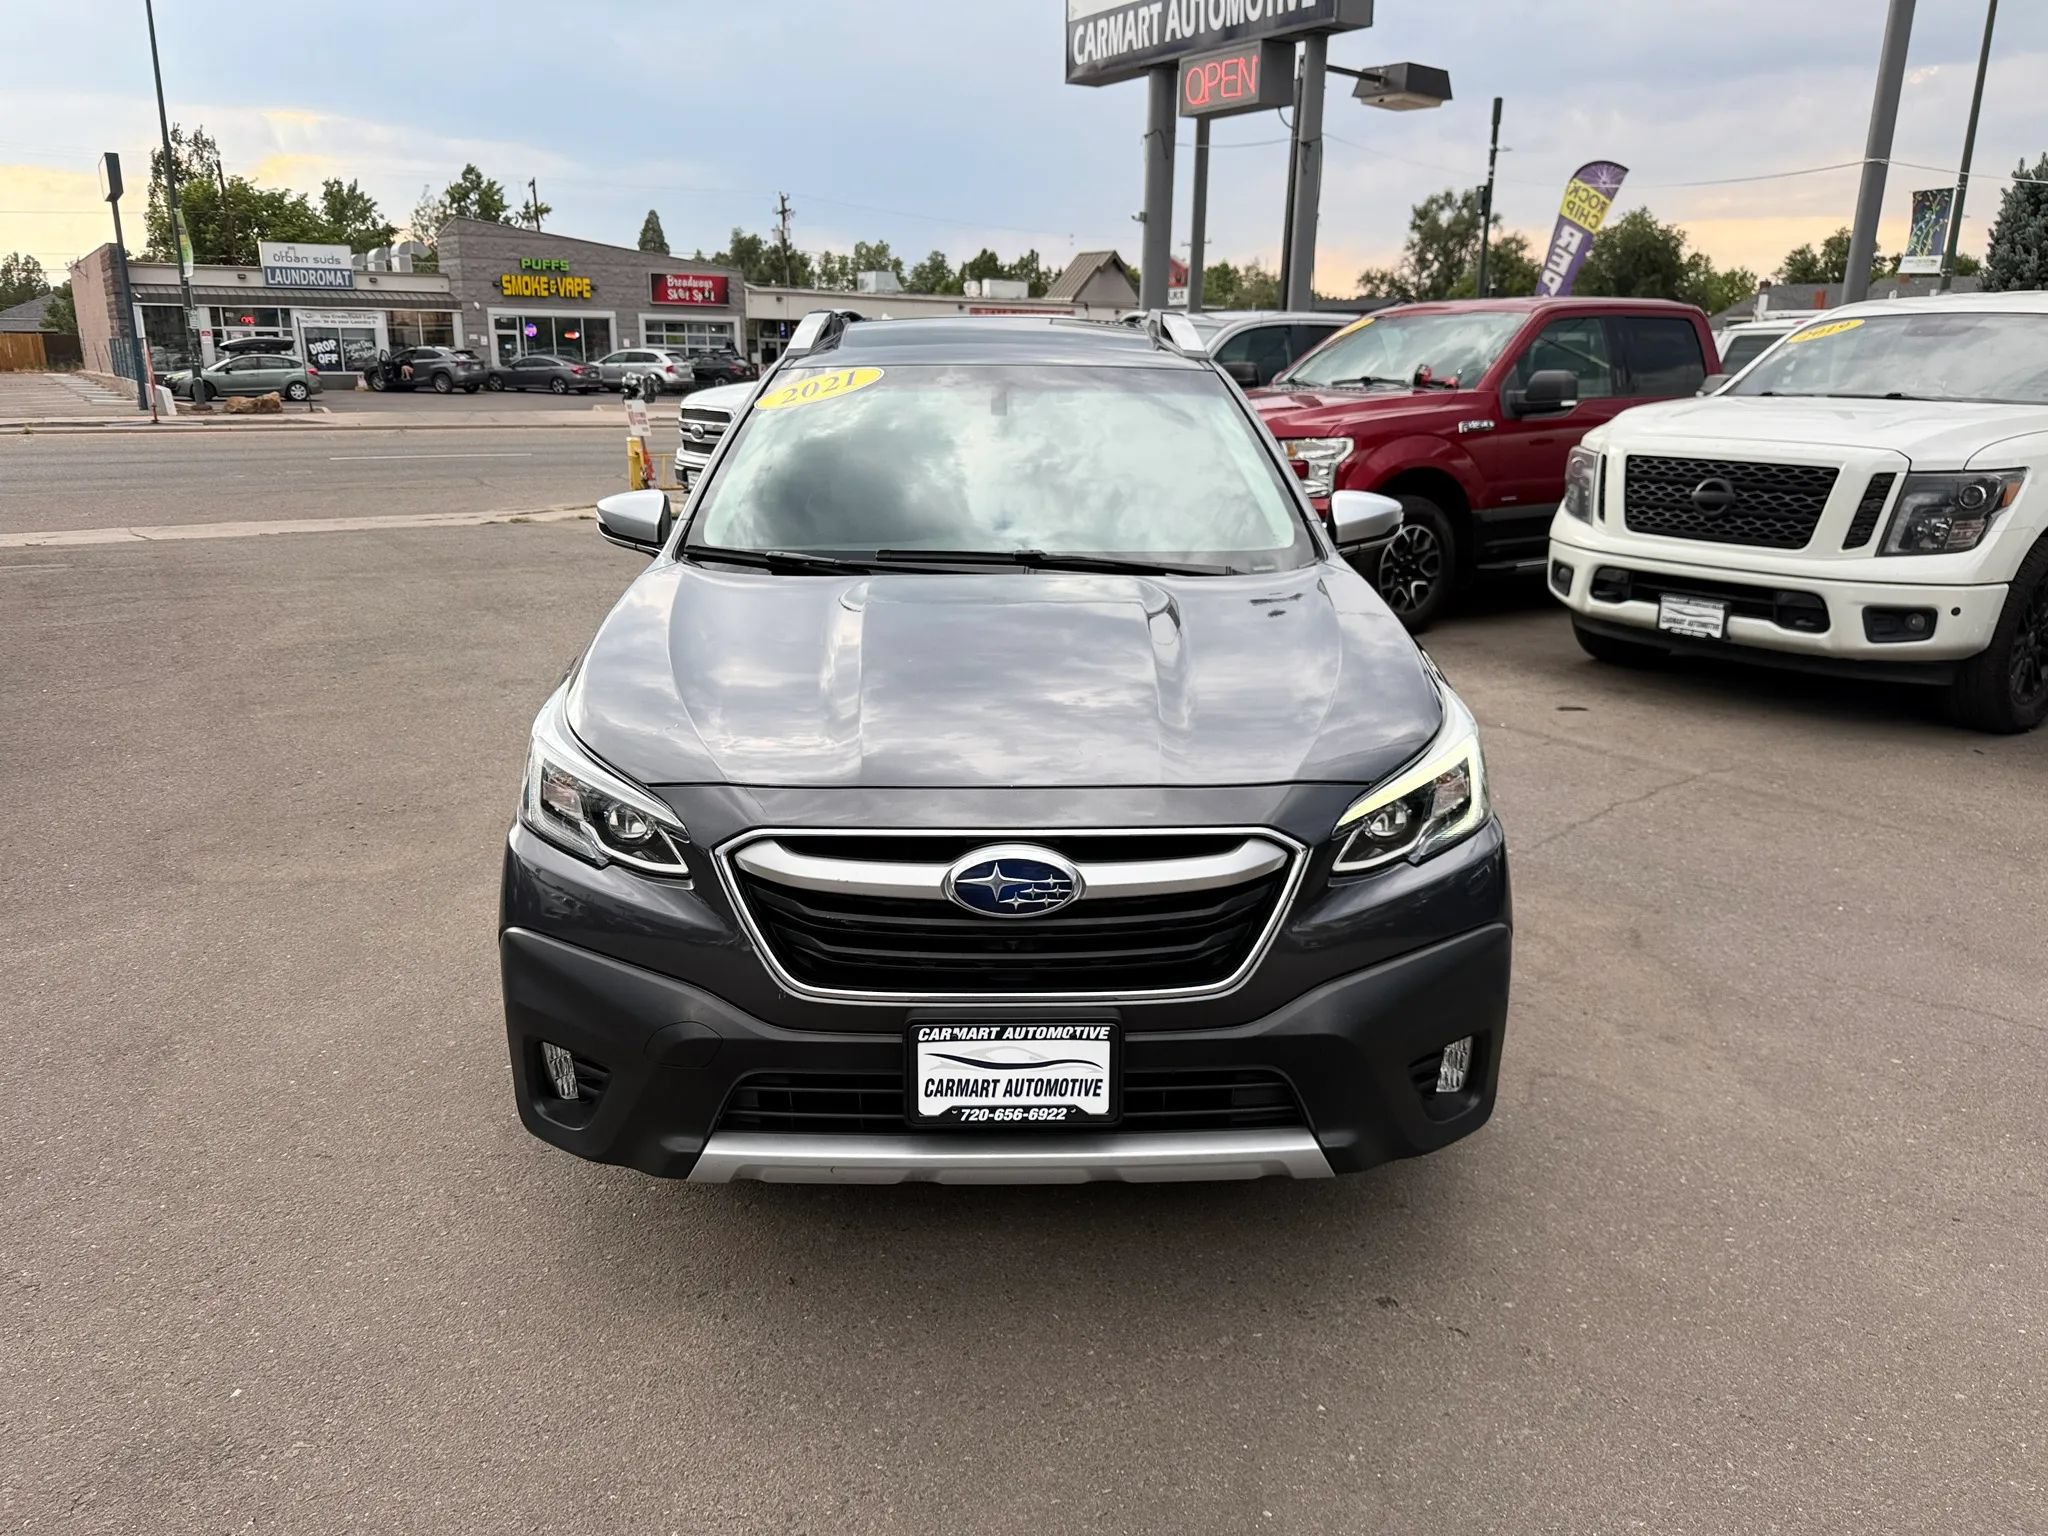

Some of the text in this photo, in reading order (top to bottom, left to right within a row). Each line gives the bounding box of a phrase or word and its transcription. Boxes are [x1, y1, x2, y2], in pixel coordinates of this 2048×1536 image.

[1074, 0, 1316, 65] CARMART AUTOMO
[1185, 55, 1258, 105] OPEN
[313, 255, 341, 265] suds
[521, 257, 570, 271] PUFFS
[267, 268, 350, 286] LAUNDROMAT
[502, 275, 549, 297] SMOKE
[557, 276, 591, 299] VAPE
[308, 339, 338, 356] DROP
[317, 353, 339, 365] OFF
[782, 370, 857, 404] 2021
[918, 1026, 1110, 1042] CARMART AUTOMOTIVE
[924, 1078, 1103, 1098] CARMART AUTOMOTIVE
[960, 1108, 1068, 1122] 720-656-6922
